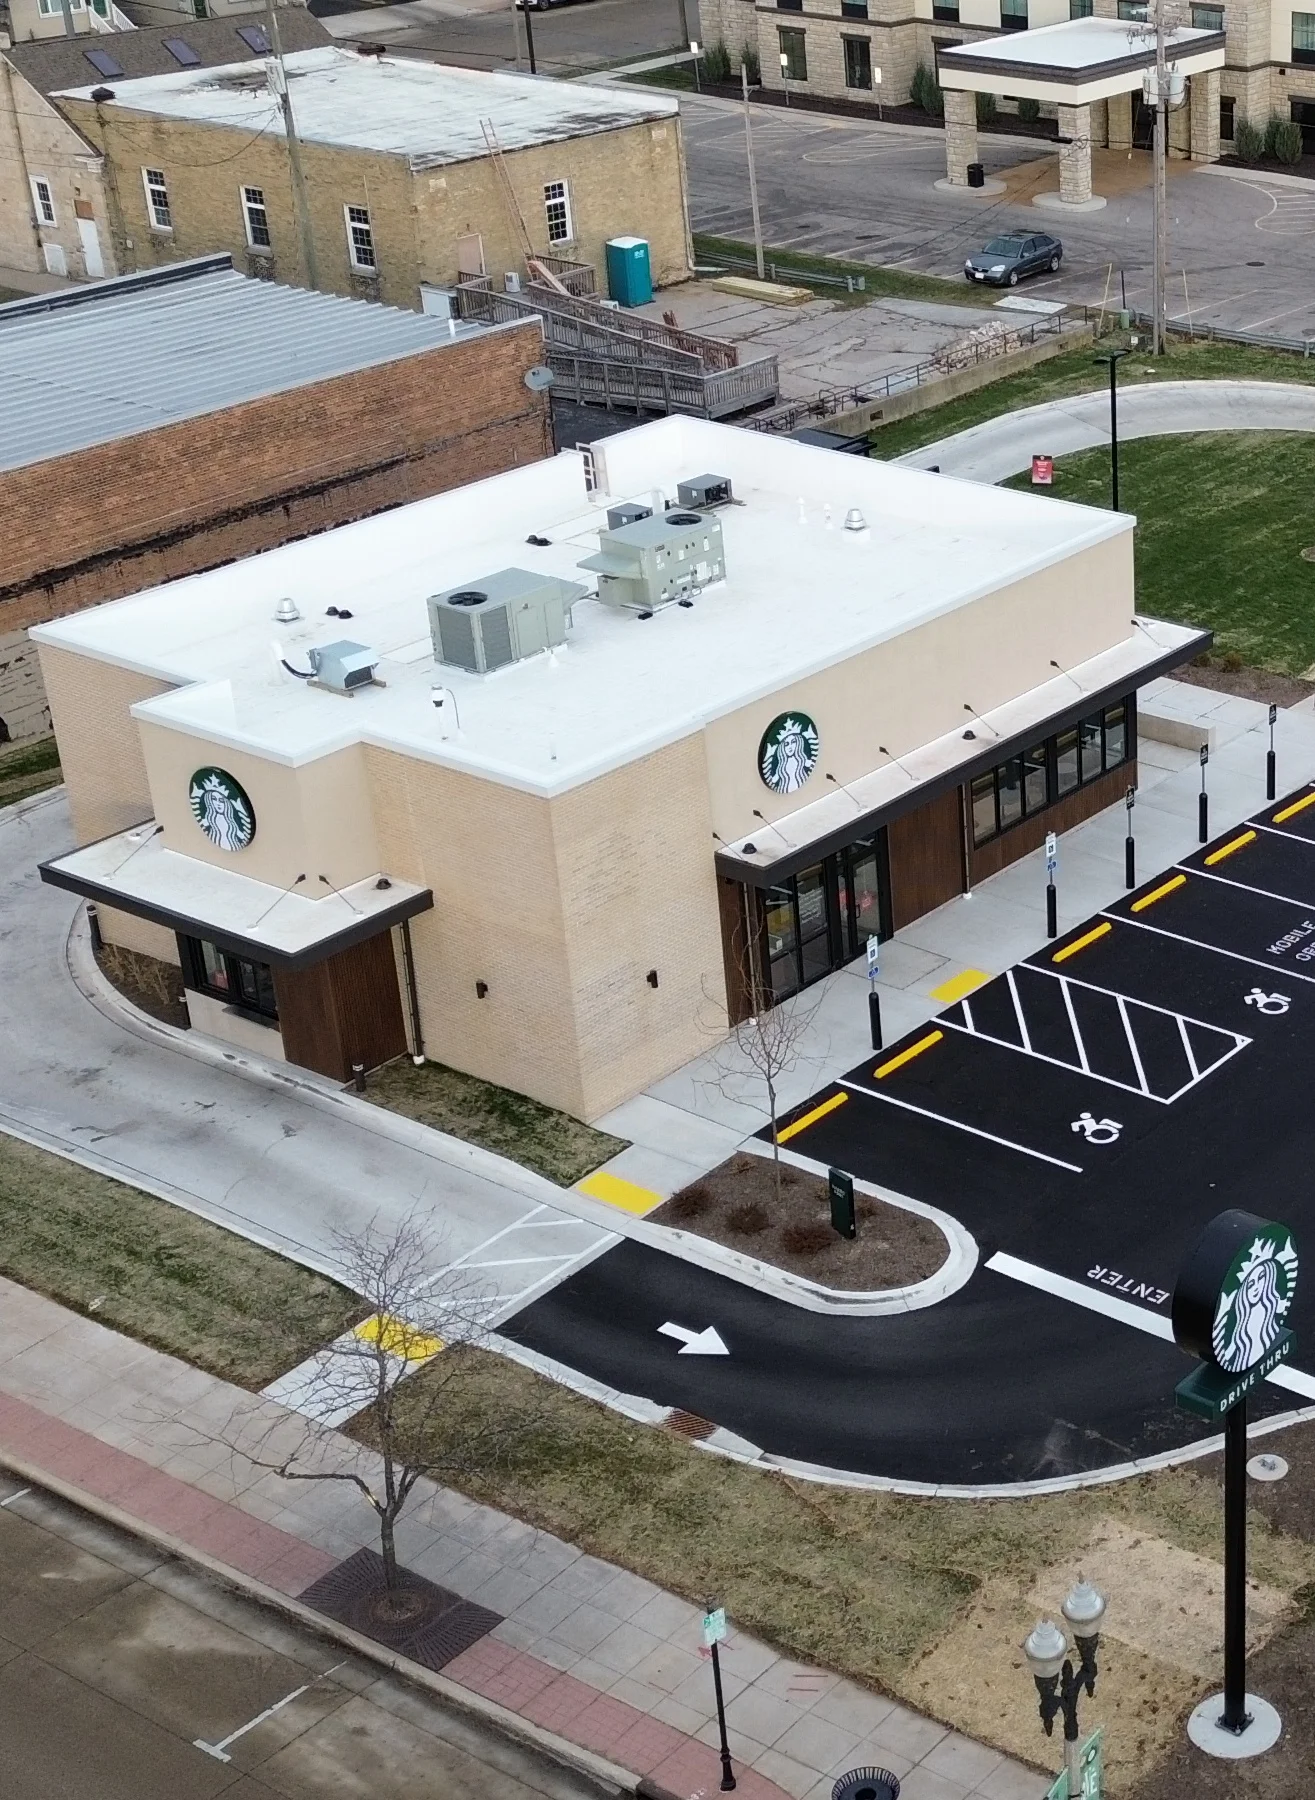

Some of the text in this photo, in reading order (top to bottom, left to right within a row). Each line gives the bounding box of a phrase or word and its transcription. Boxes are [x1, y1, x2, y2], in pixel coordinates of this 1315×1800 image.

[1266, 920, 1315, 954] MOBILE
[1087, 1264, 1170, 1305] ENTER
[1219, 1341, 1291, 1412] DRIVE THRU
